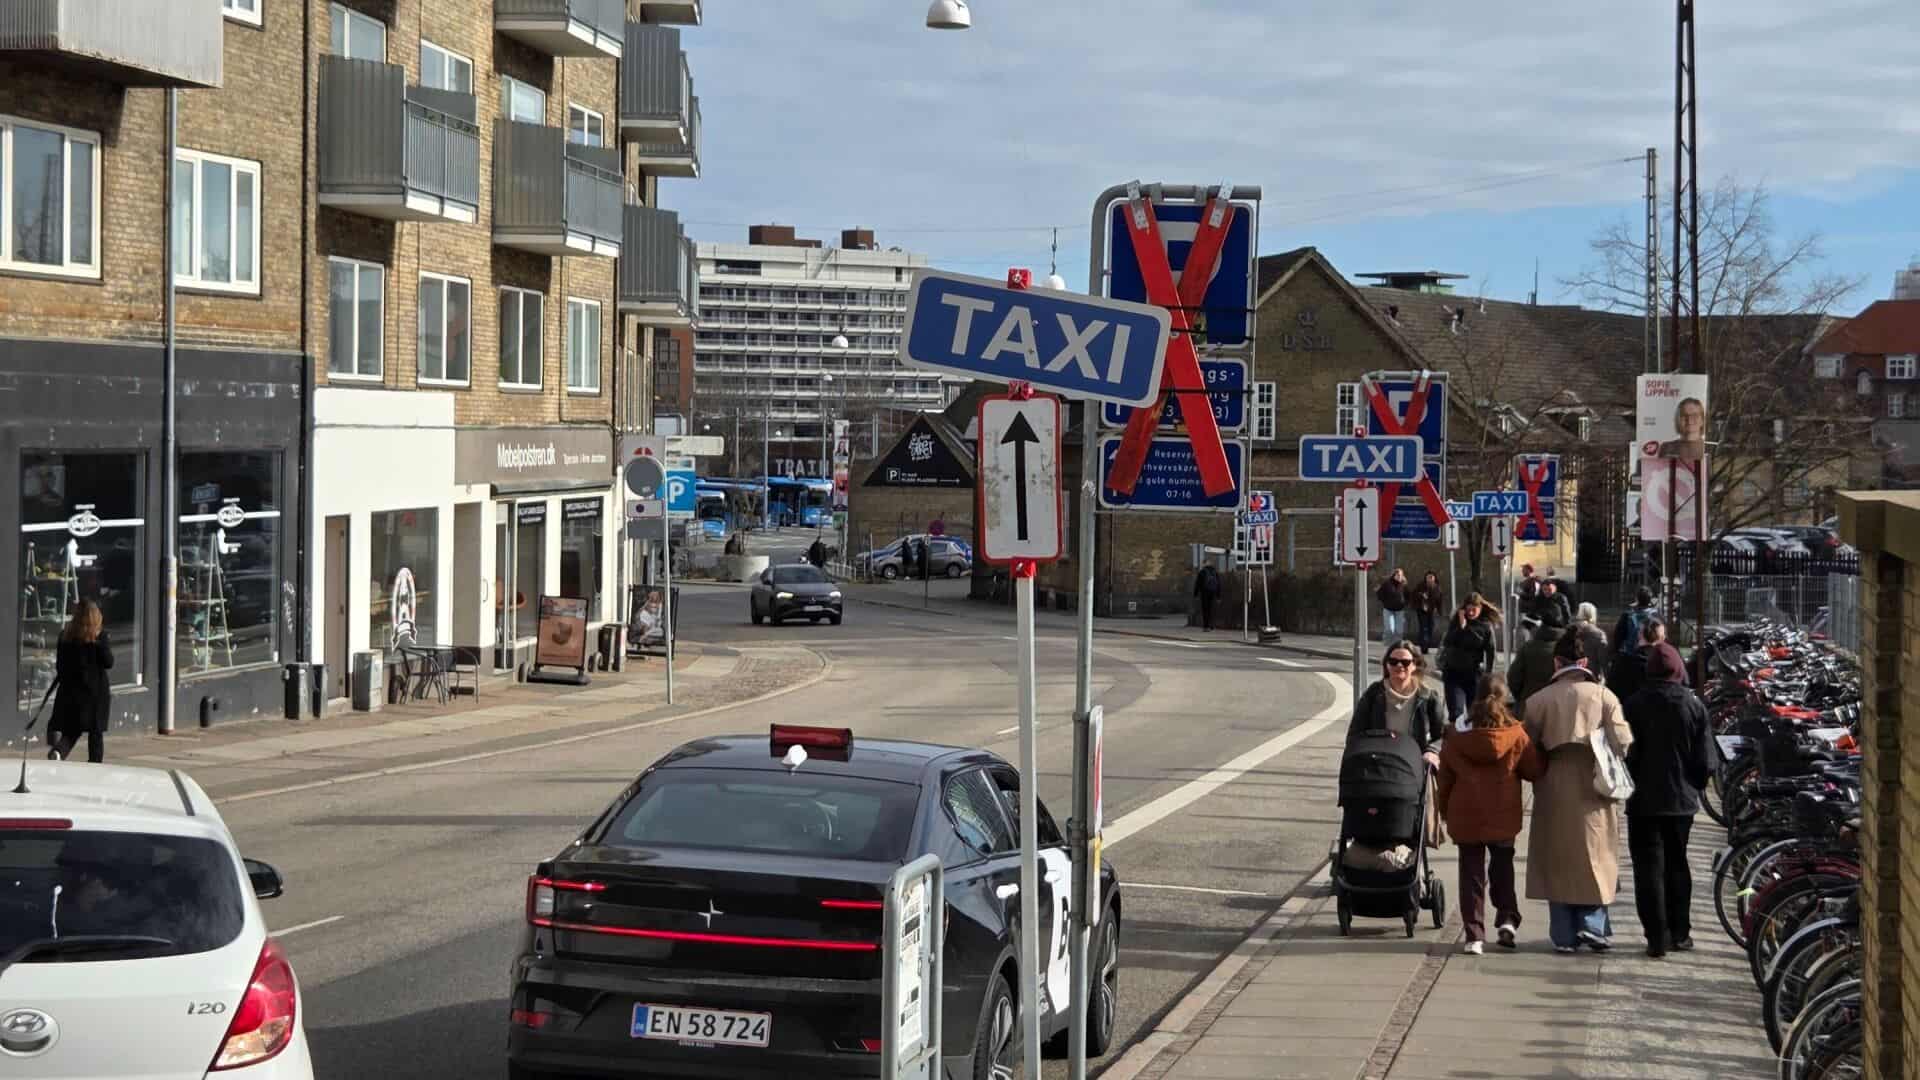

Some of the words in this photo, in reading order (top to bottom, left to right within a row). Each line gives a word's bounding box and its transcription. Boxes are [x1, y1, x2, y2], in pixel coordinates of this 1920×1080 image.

[941, 293, 1132, 384] TAXI
[1313, 445, 1404, 472] TAXI
[889, 470, 898, 480] P
[669, 481, 685, 504] P
[1476, 496, 1522, 511] TAXI
[1446, 505, 1469, 517] AXI
[650, 1010, 682, 1034] EN
[687, 1013, 716, 1037] 58
[722, 1016, 766, 1041] 724
